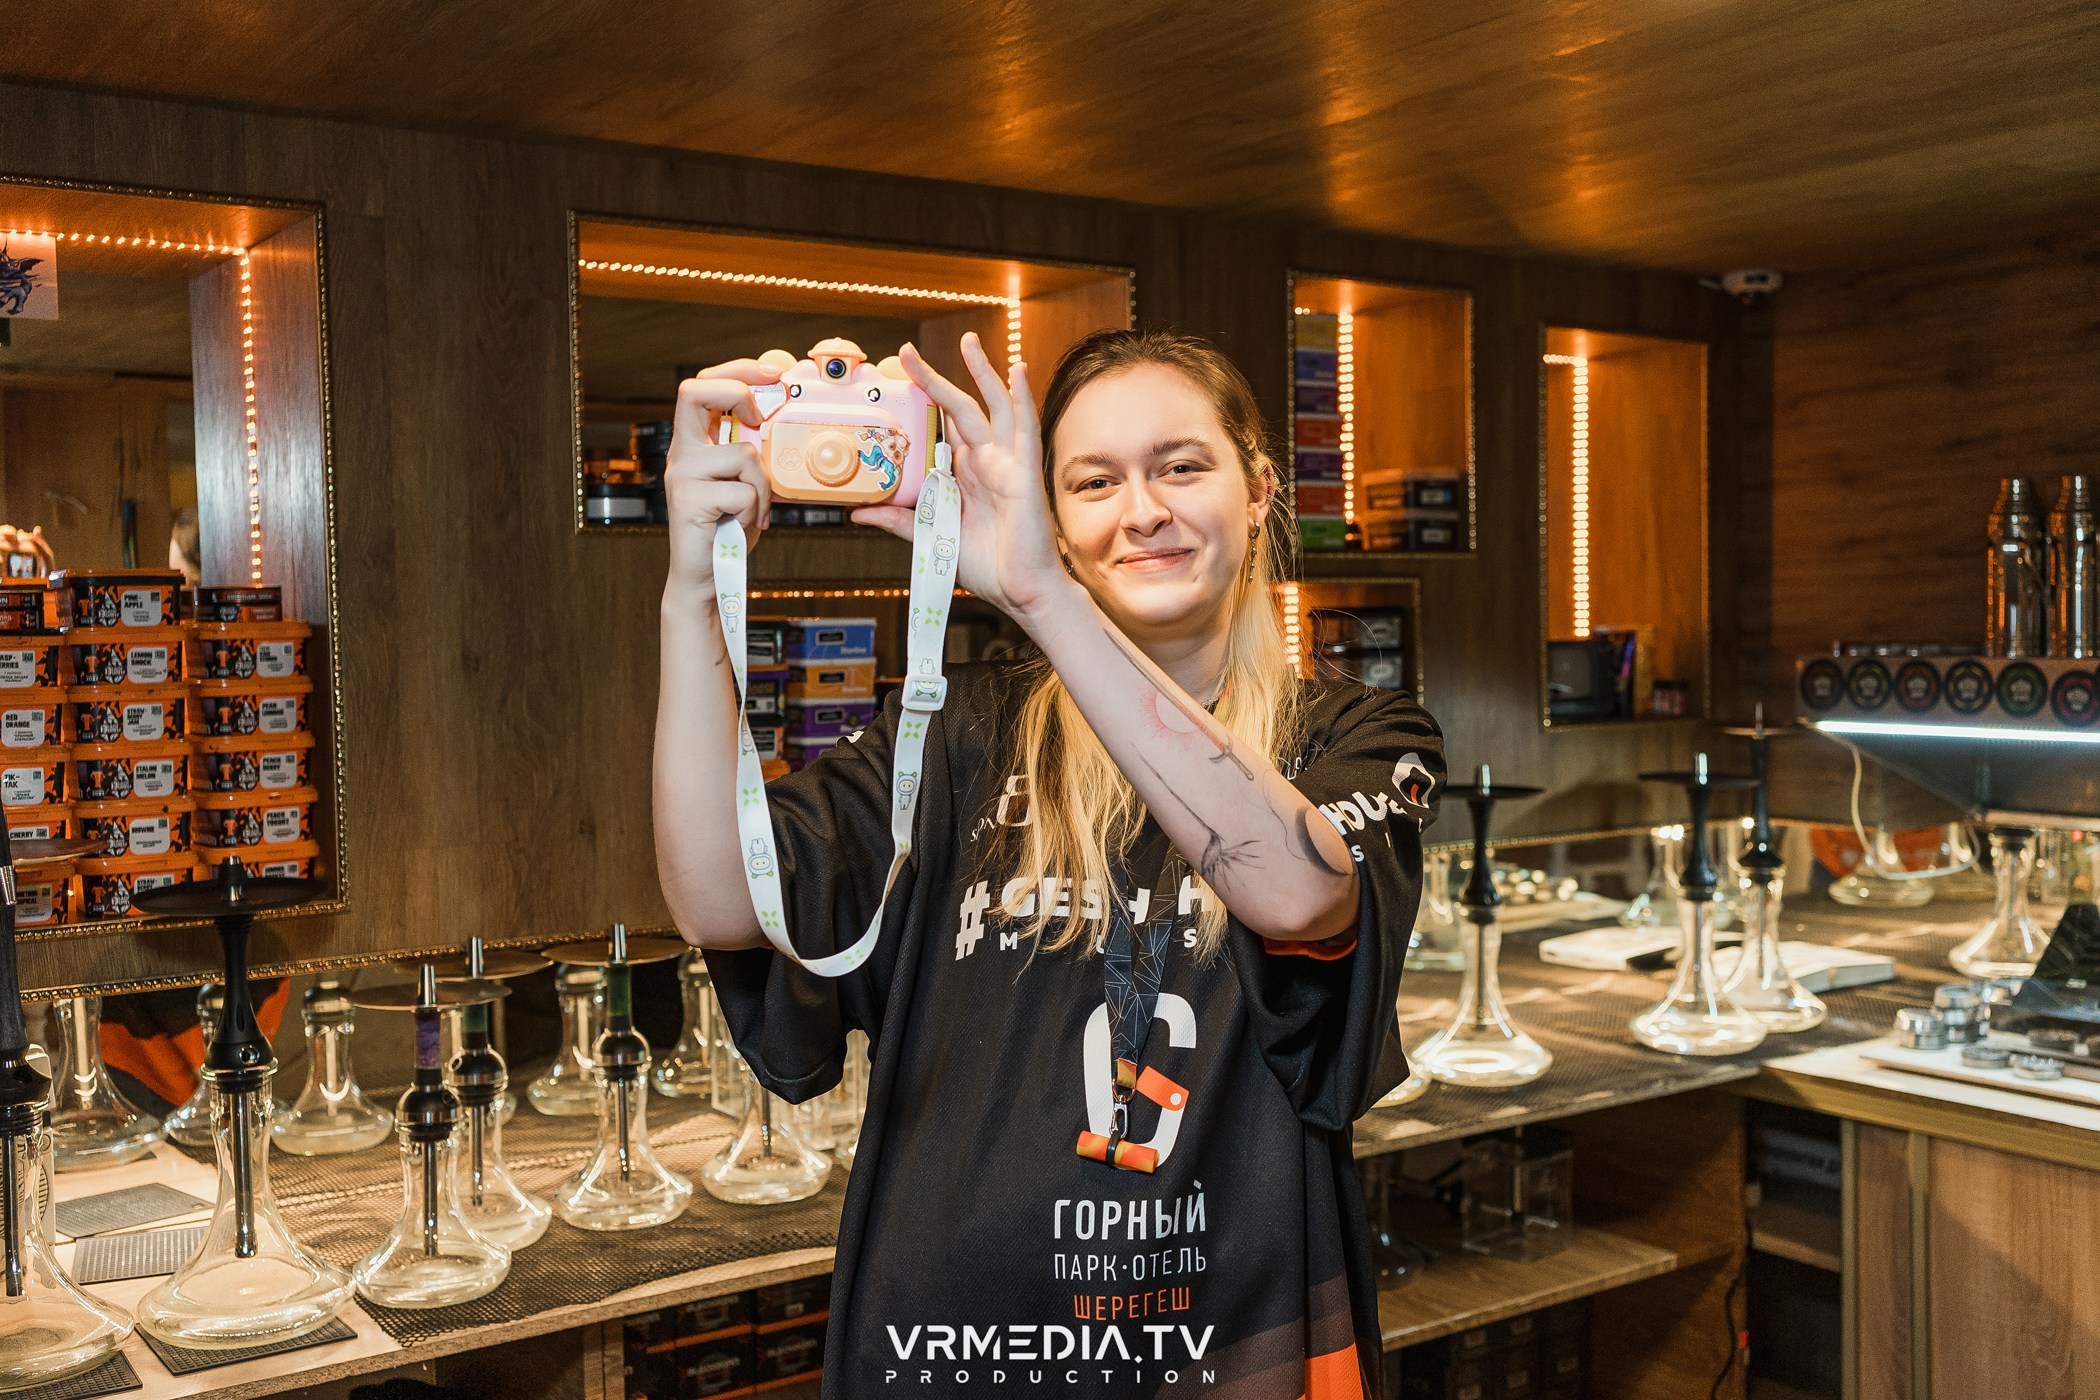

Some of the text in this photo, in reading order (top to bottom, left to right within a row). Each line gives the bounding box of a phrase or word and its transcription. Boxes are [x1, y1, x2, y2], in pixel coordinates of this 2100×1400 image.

[9, 831, 34, 839] CHERRY
[1054, 1179, 1206, 1240] ГОРНЫЙ
[1074, 1287, 1190, 1321] ШЕРЕГЕШ
